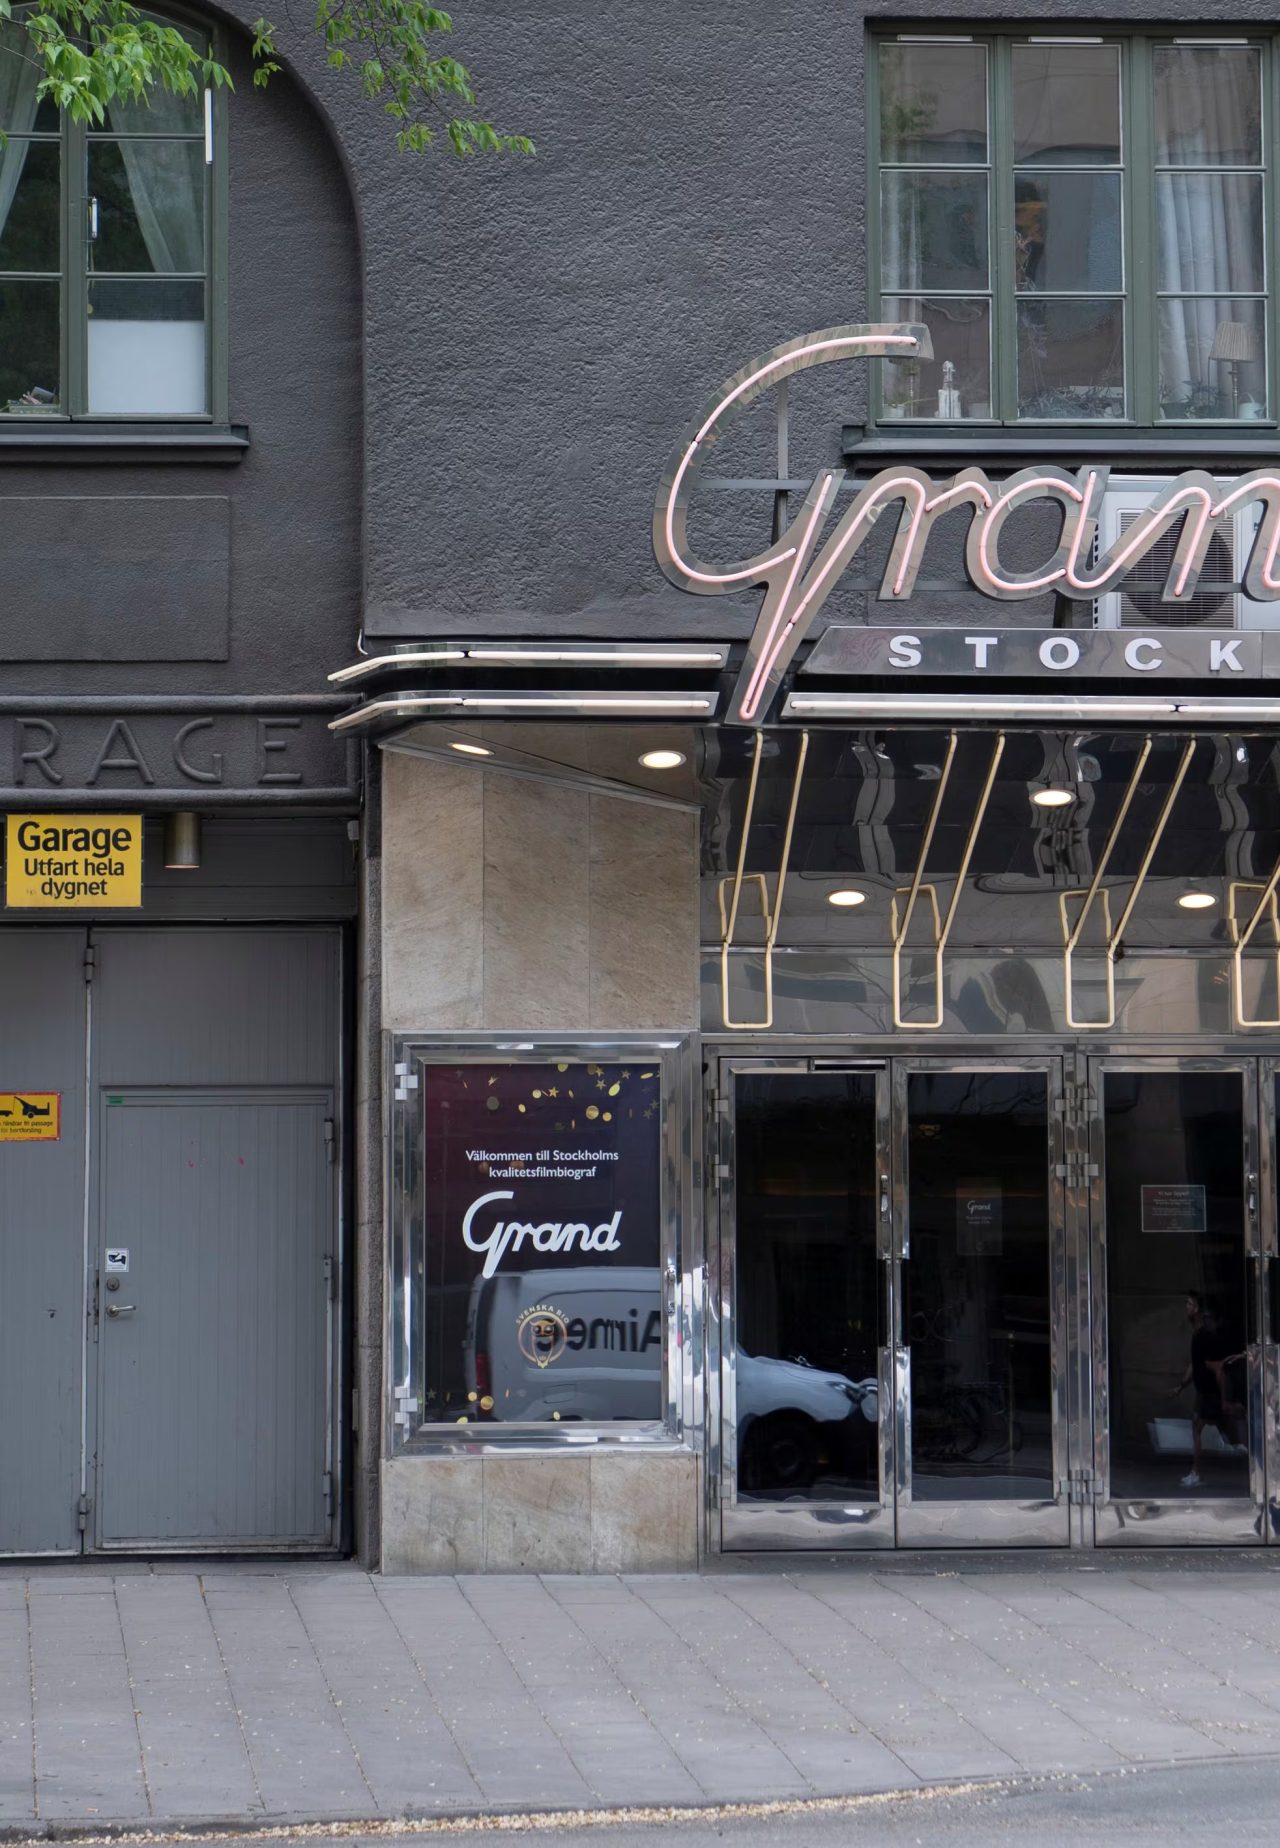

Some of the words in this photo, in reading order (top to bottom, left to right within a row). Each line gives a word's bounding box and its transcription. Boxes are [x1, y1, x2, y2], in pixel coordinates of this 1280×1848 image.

[13, 717, 303, 785] RAGE
[17, 821, 132, 858] Garage
[24, 858, 79, 876] Utfart
[84, 858, 125, 876] hela
[41, 878, 108, 899] dygnet
[465, 1150, 533, 1161] Välkommen
[536, 1150, 550, 1161] till
[552, 1150, 619, 1161] Stockholms
[489, 1166, 597, 1180] kvalitetsfilmbiograf
[967, 1200, 992, 1215] Grand
[462, 1190, 623, 1280] Grand
[515, 1304, 554, 1324] SVENSKA
[556, 1309, 570, 1324] BIO
